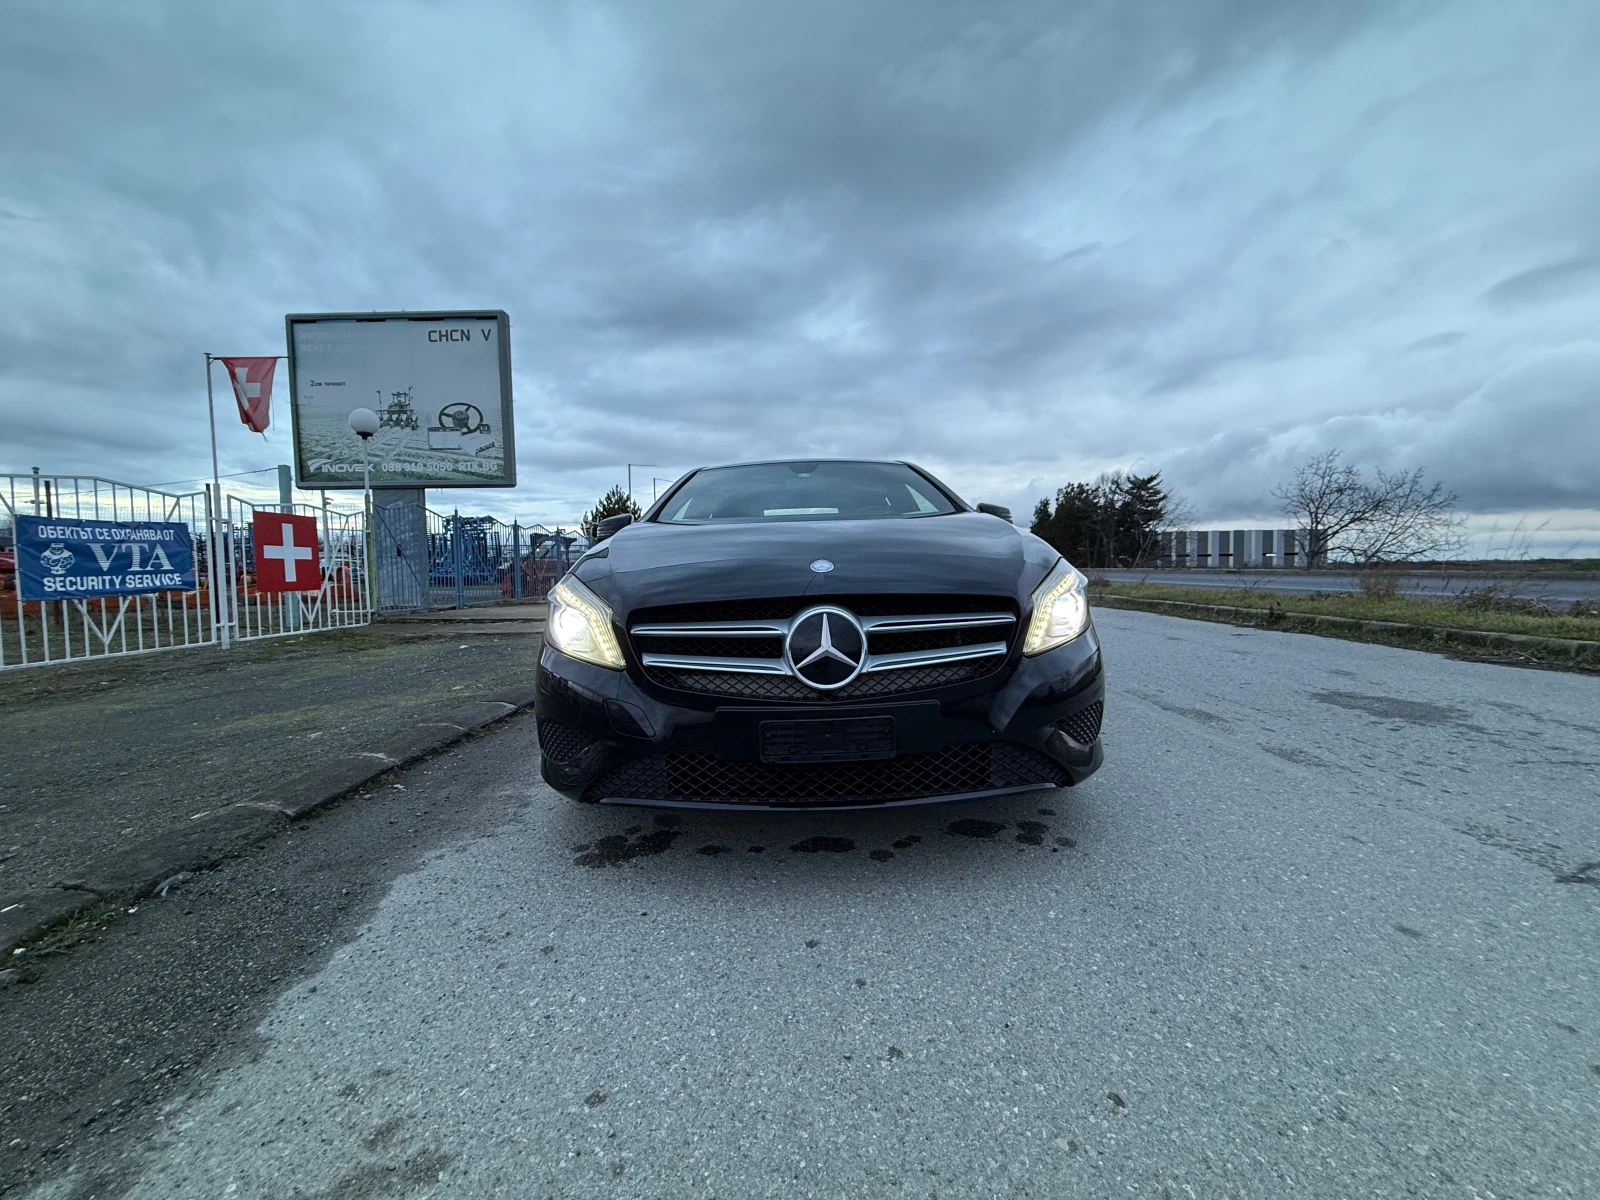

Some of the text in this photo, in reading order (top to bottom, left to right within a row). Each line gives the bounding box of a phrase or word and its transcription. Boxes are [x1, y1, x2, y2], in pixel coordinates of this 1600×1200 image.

[381, 463, 401, 472] 088
[426, 462, 453, 472] 5050
[38, 525, 175, 541] ОБЕКТЪТ СЕ ОХРАНЯВА ОТ
[86, 542, 175, 572] VTA
[43, 573, 183, 592] SECURITY SERVICE
